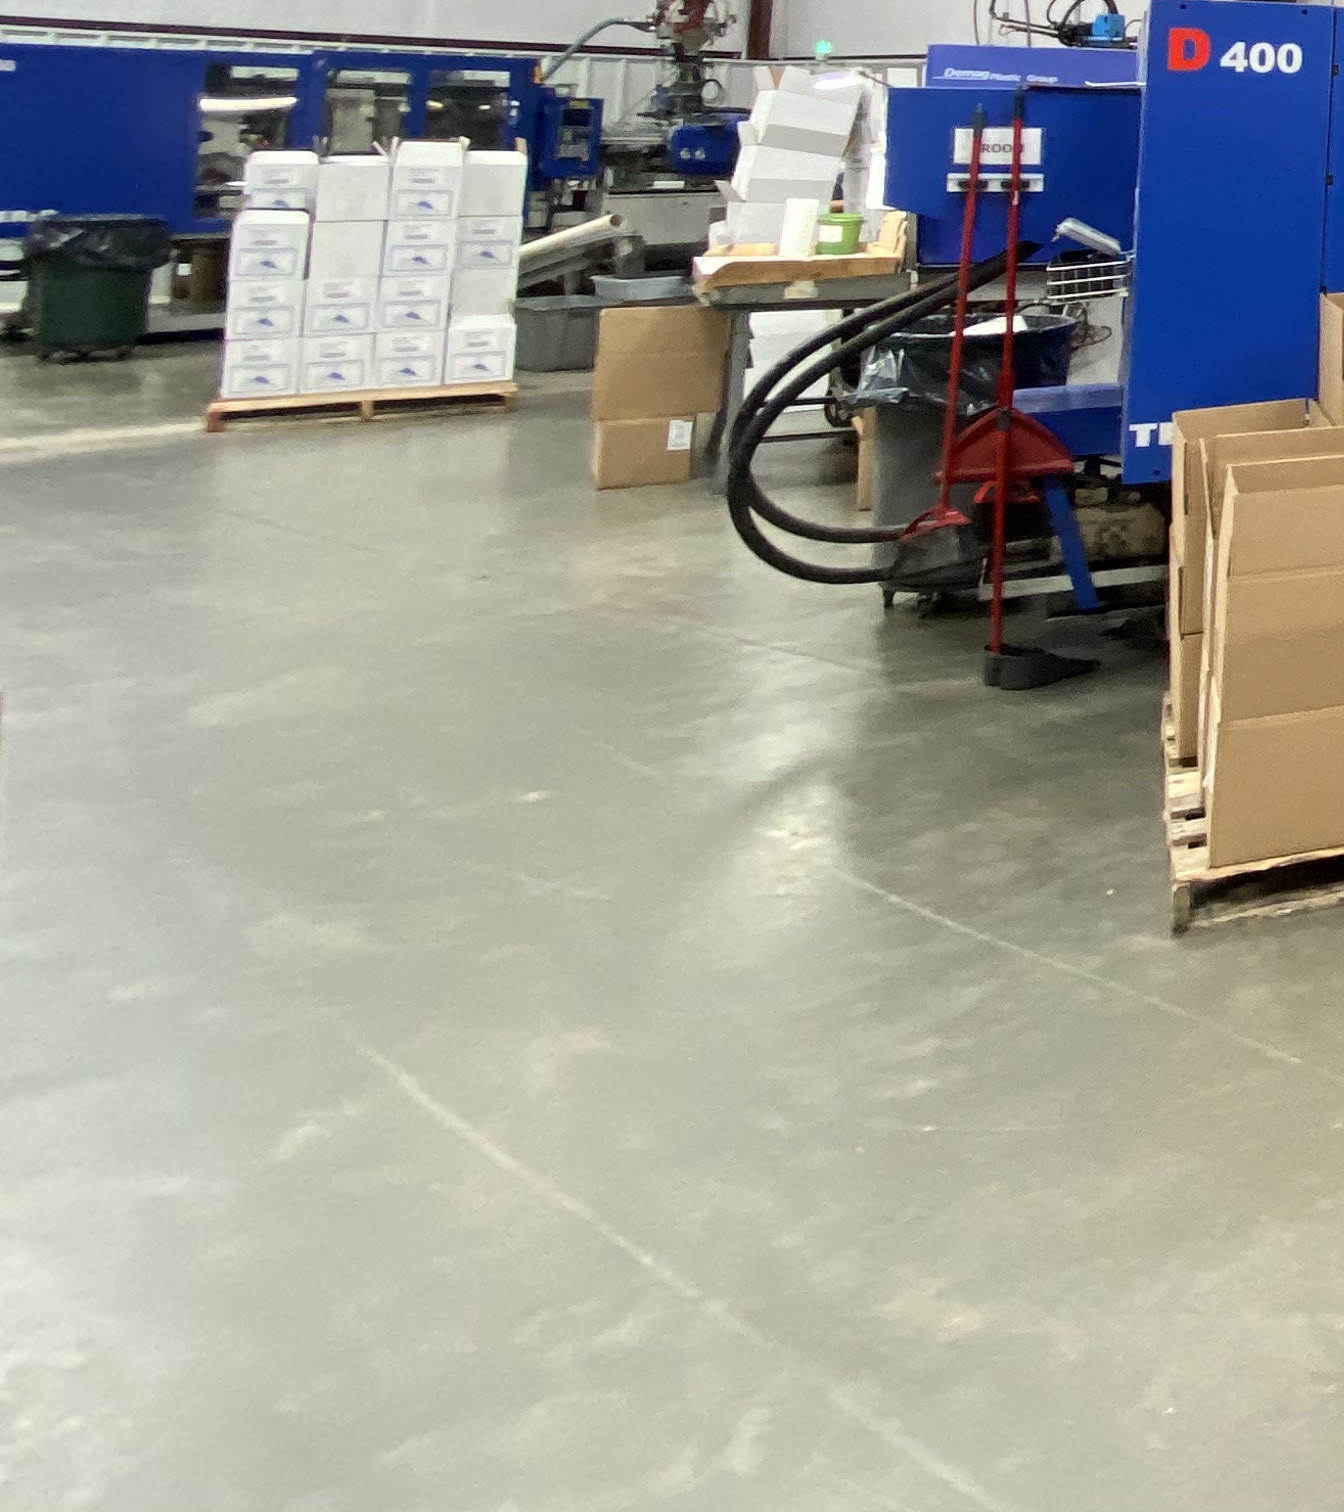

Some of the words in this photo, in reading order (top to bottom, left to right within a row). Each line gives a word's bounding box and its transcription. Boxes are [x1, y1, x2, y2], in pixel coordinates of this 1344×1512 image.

[1167, 27, 1211, 71] D
[1220, 41, 1303, 74] 400
[943, 67, 990, 81] Demag
[979, 143, 1025, 154] ROO
